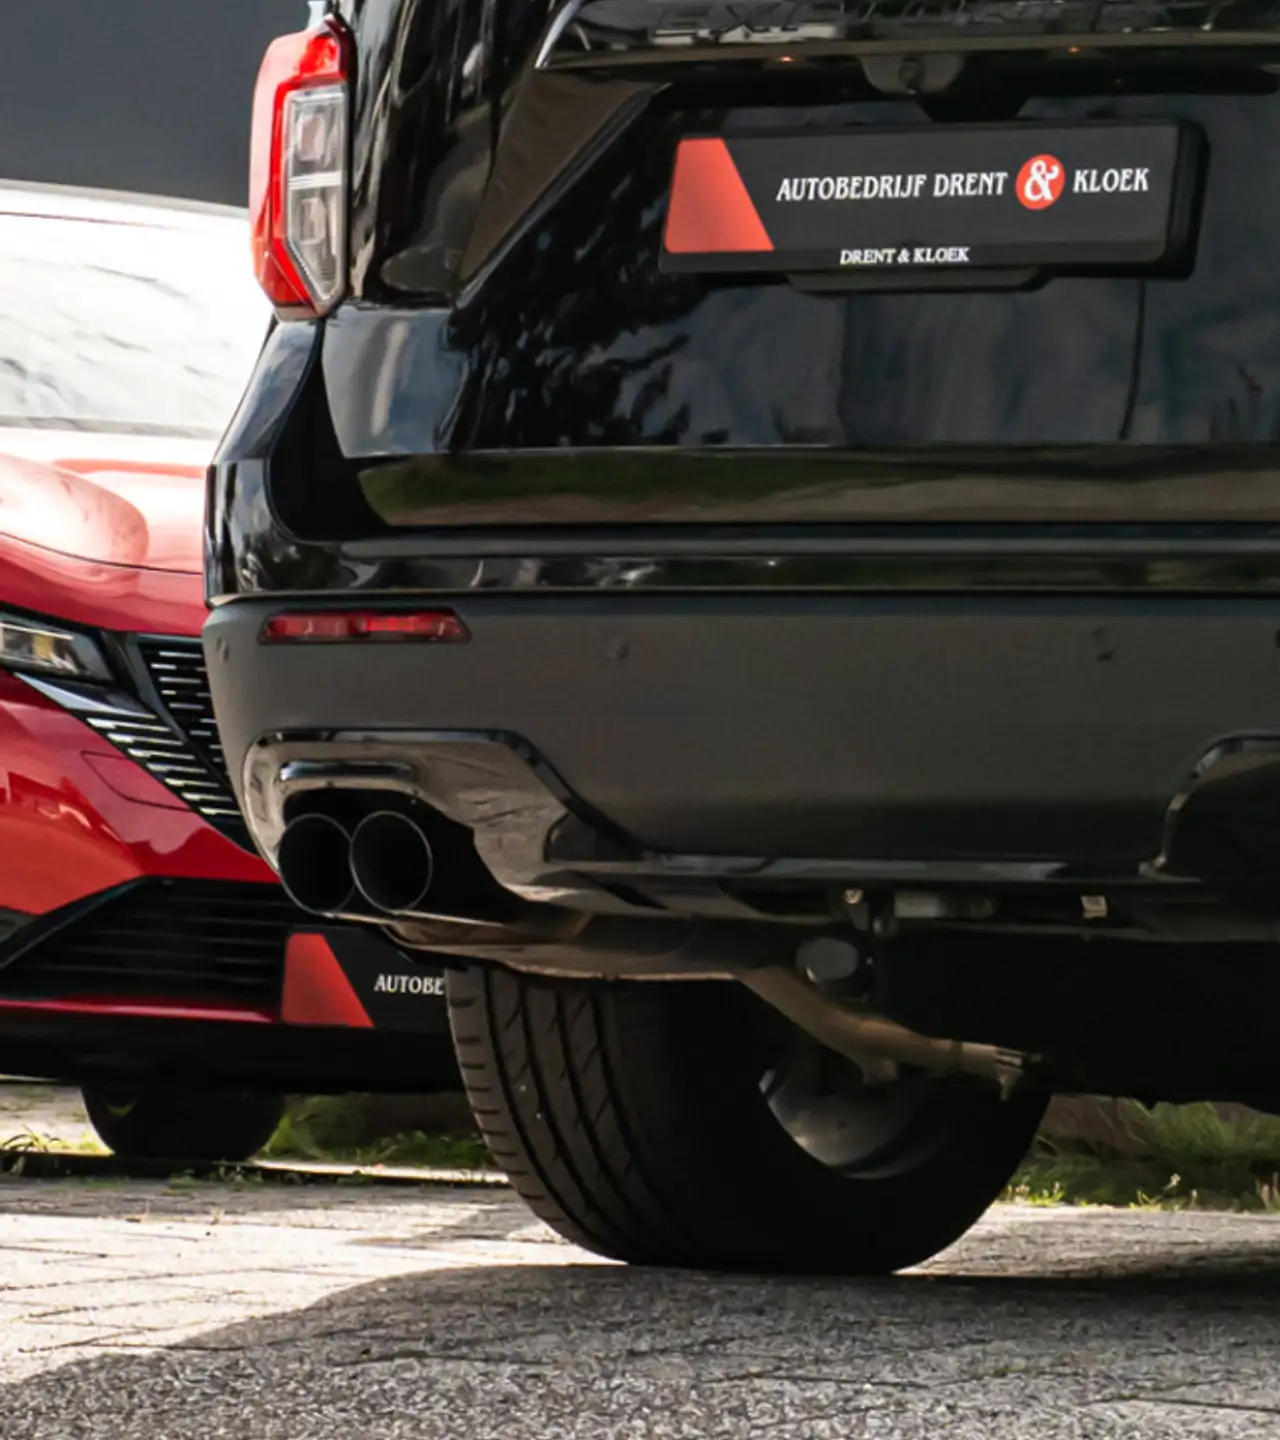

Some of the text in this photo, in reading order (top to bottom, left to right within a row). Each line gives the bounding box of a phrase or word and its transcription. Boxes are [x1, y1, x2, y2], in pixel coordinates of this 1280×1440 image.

[776, 160, 1150, 202] AUTOBEDRIJF DRENT & KLOEK
[839, 246, 970, 265] DRENT & KLOEK
